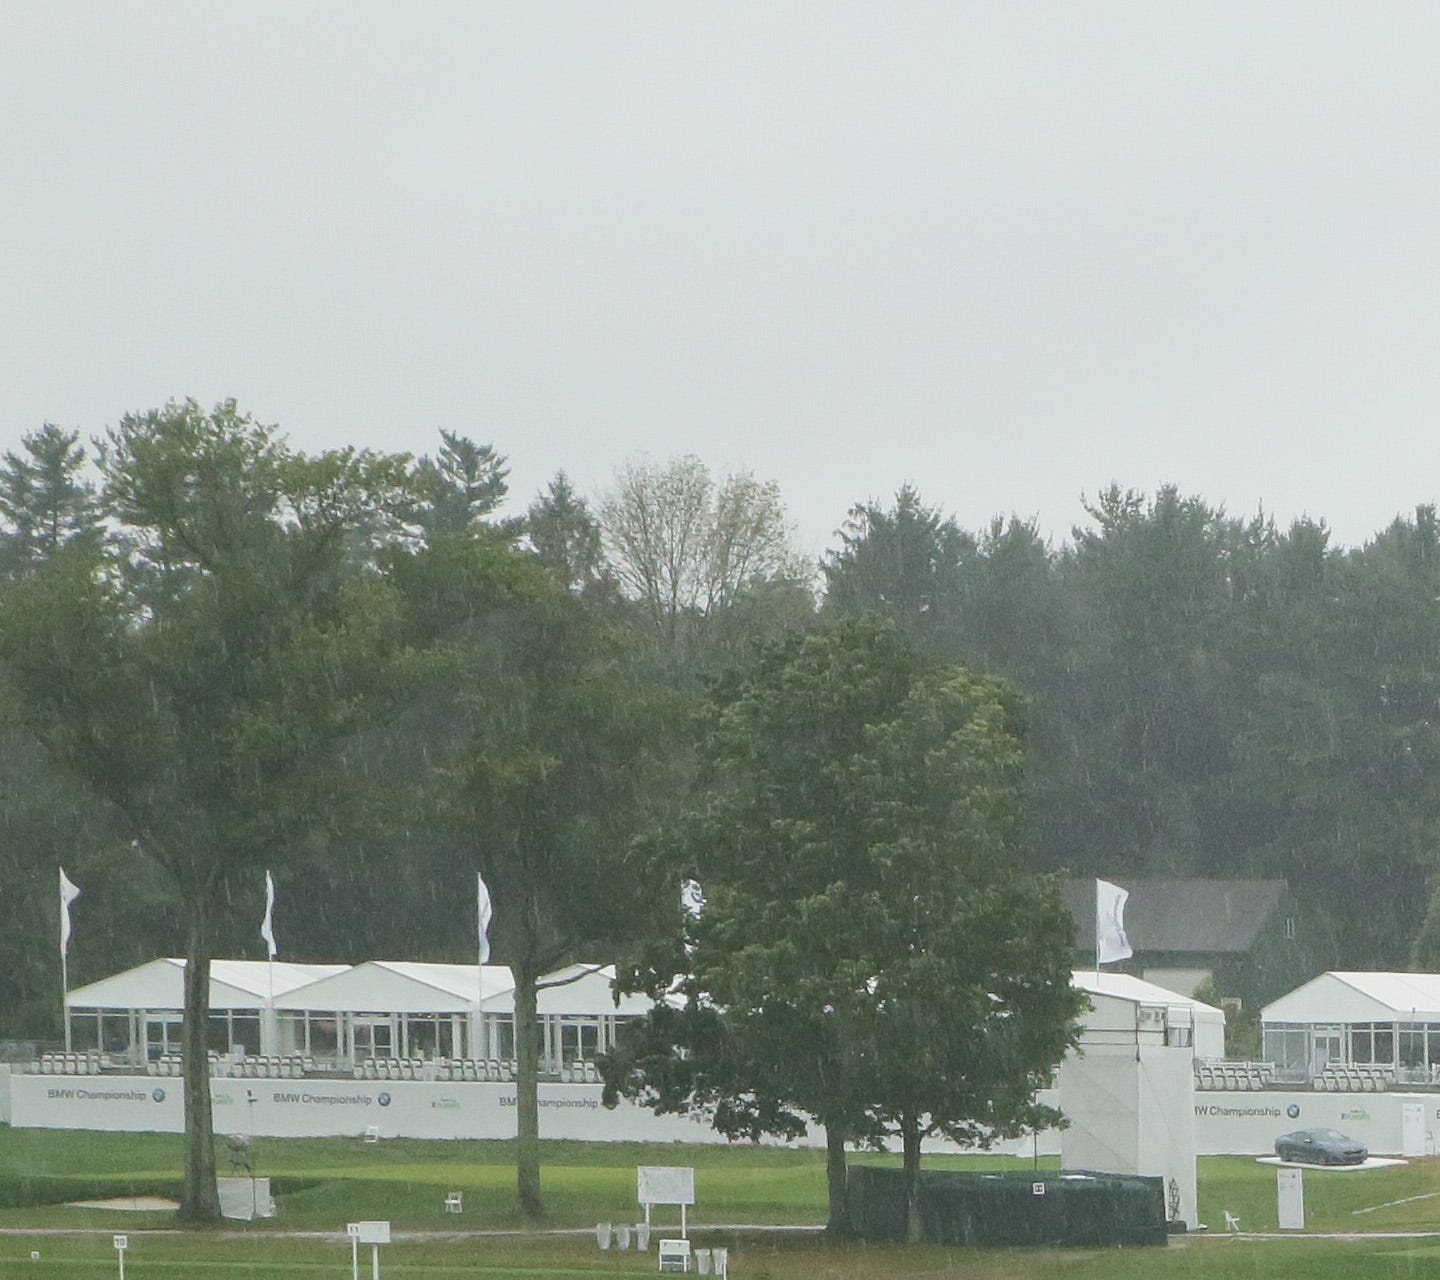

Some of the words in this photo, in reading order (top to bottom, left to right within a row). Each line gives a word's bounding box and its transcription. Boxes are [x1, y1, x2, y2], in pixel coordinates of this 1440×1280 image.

[47, 1089, 74, 1099] BMW
[76, 1089, 147, 1101] Championship
[273, 1093, 300, 1103] BMW
[301, 1094, 372, 1106] Championship
[1209, 1106, 1281, 1118] Championship
